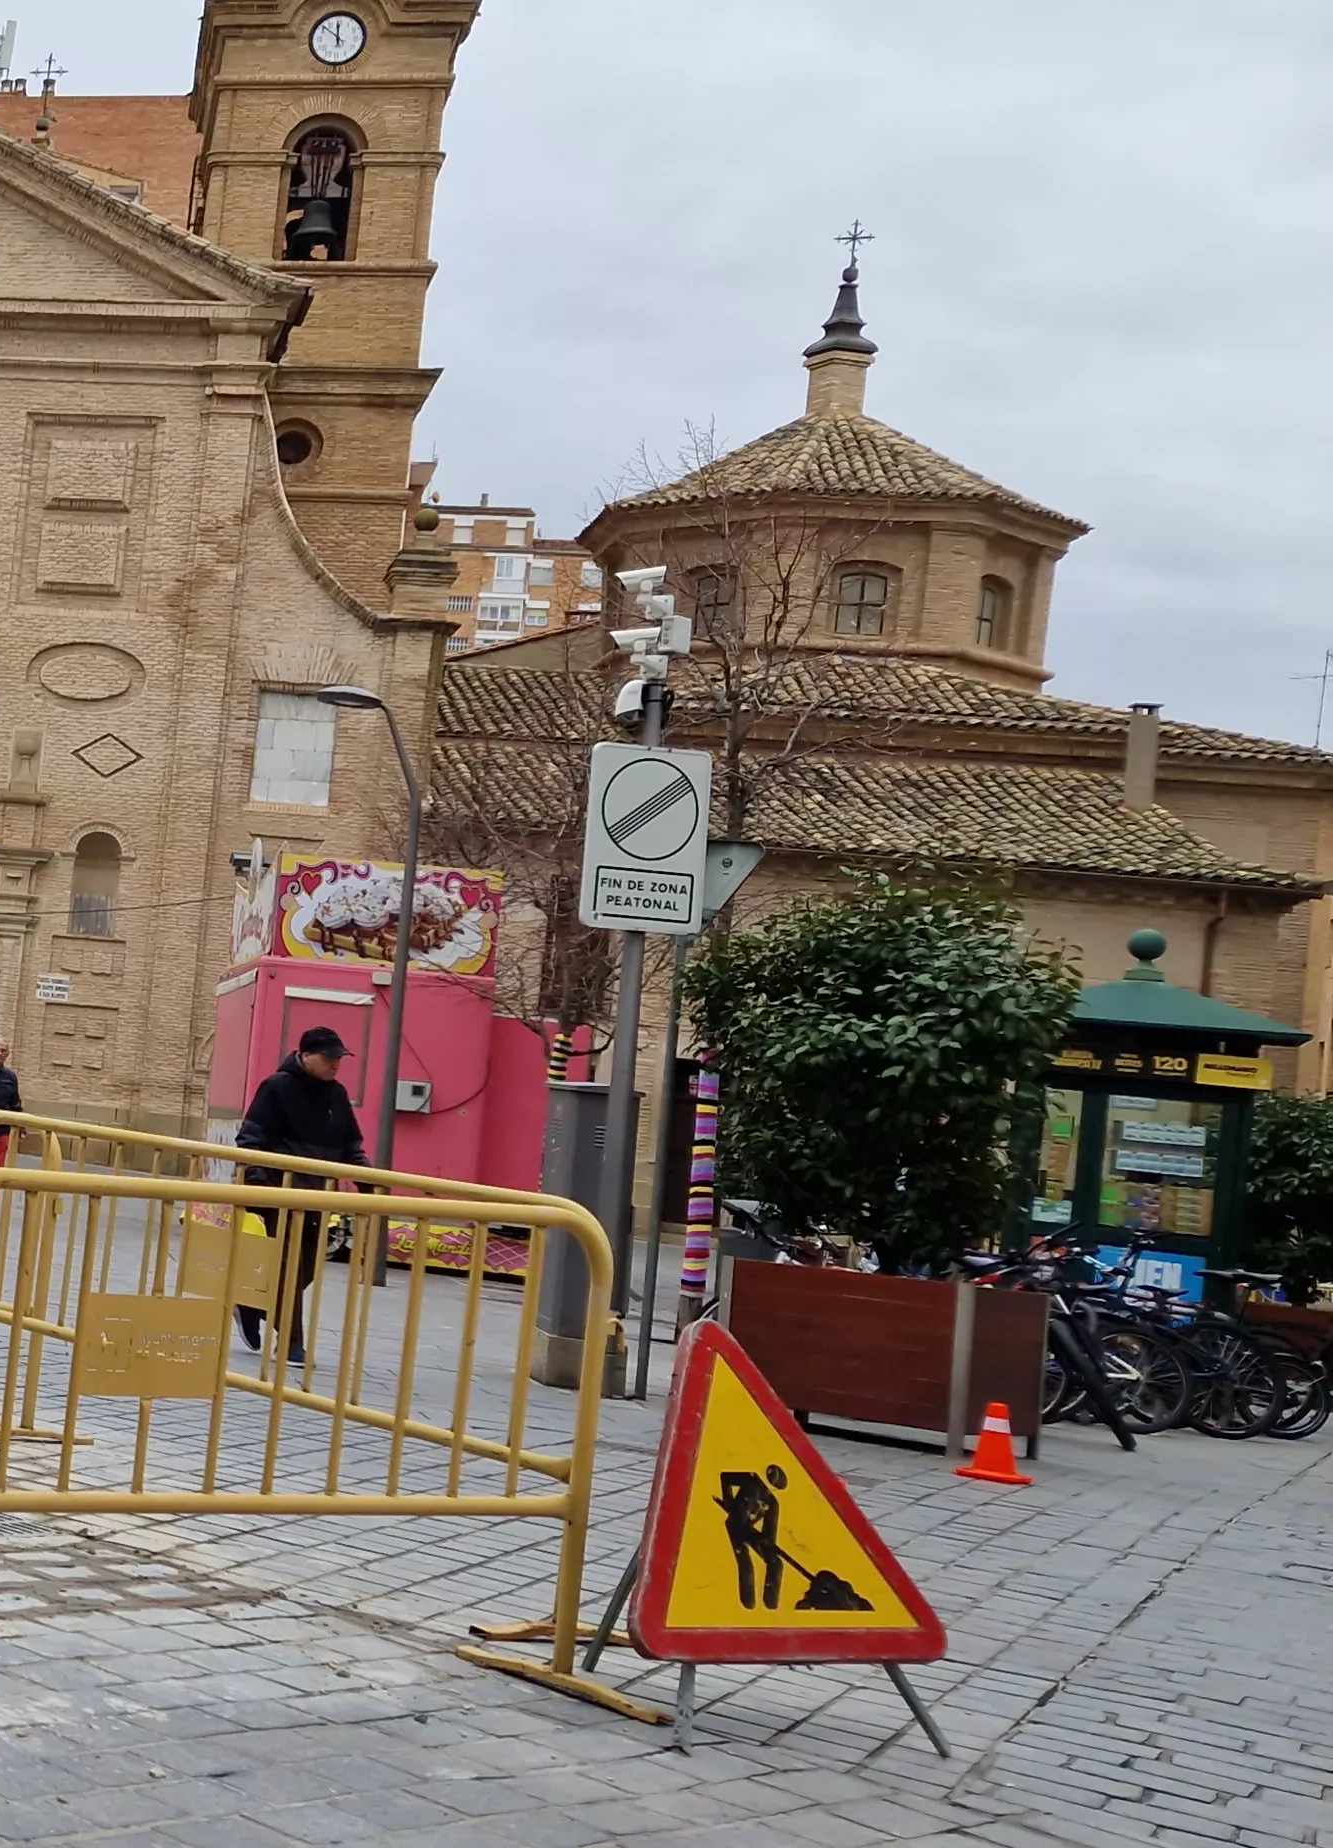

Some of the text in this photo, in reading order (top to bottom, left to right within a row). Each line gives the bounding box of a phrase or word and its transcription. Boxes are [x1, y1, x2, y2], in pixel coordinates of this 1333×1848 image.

[600, 877, 688, 895] FIN DE ZONA
[606, 895, 679, 911] PEATONAL
[1153, 1056, 1188, 1071] 120
